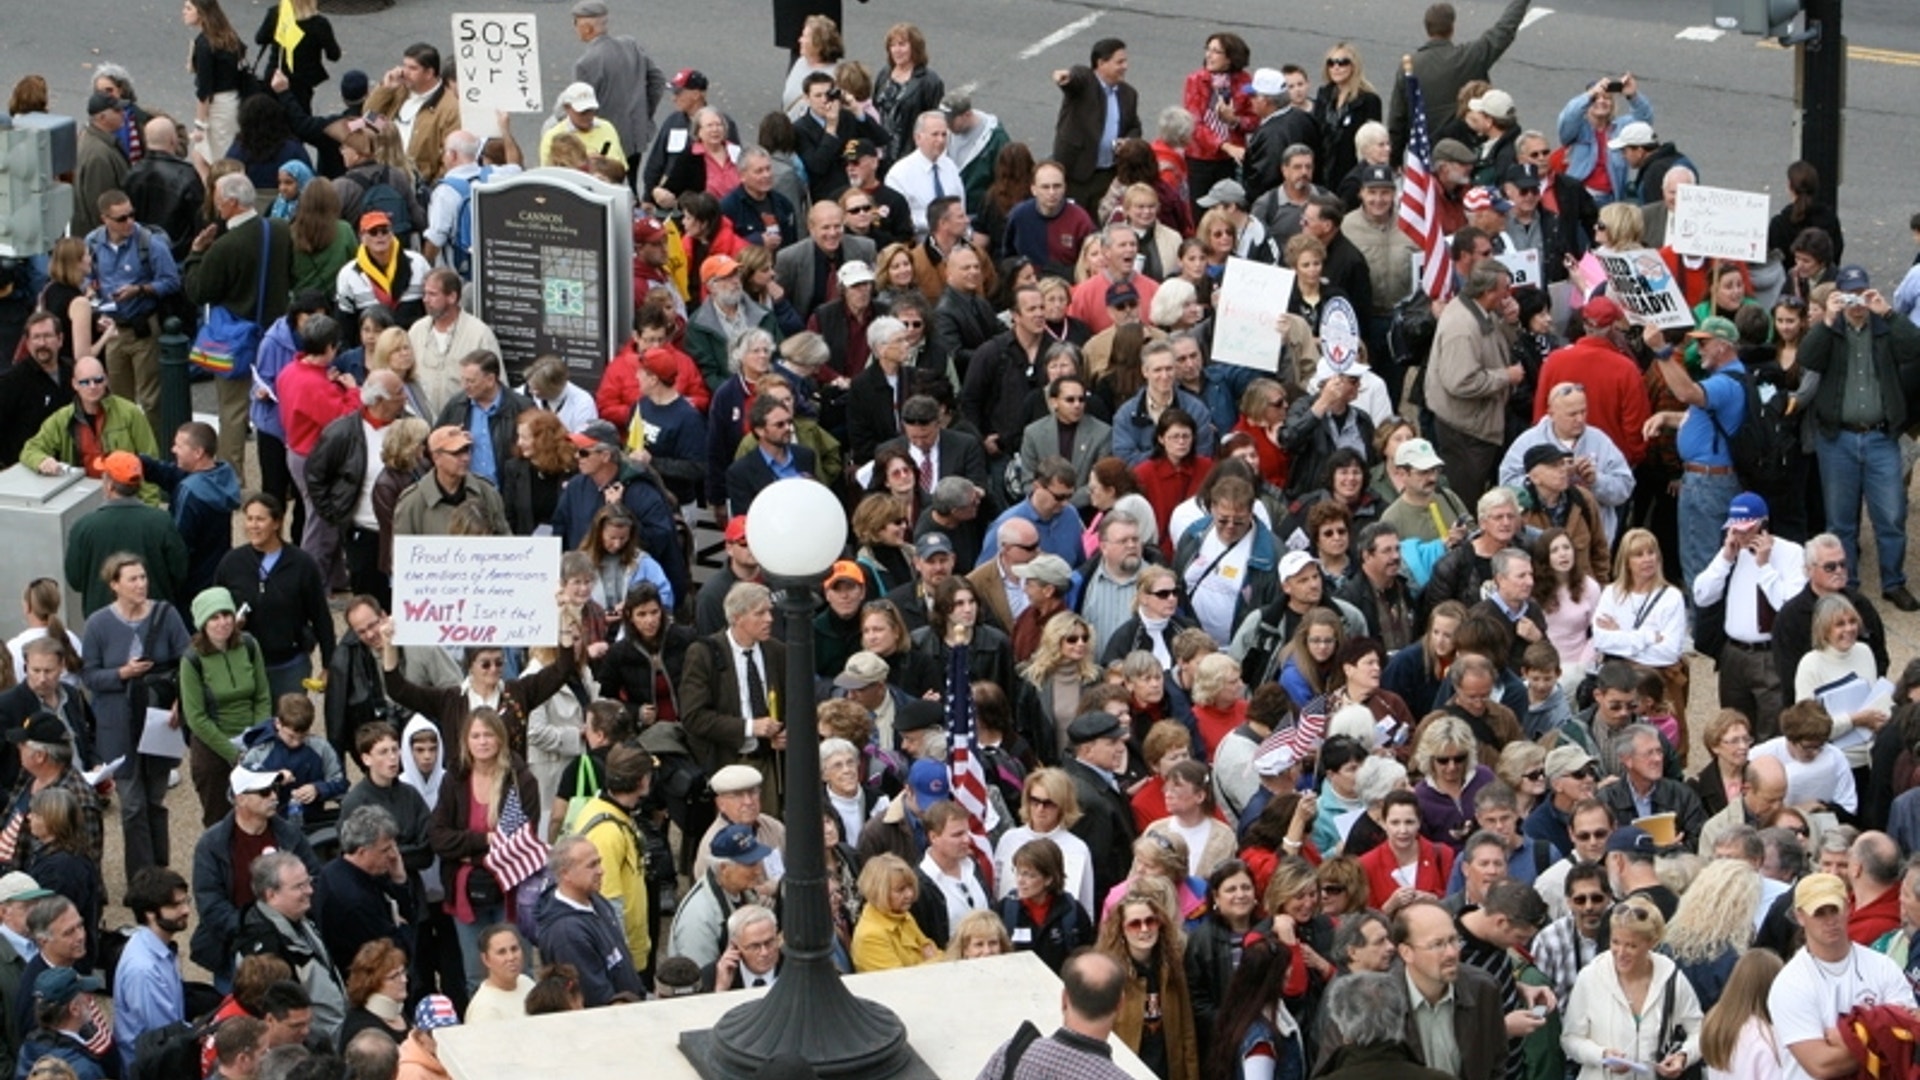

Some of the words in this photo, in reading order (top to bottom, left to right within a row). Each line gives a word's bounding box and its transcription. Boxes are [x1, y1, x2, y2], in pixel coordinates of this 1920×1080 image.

[519, 210, 563, 223] CANNON
[409, 544, 450, 564] Proud
[453, 548, 467, 564] to
[470, 546, 534, 566] represent
[485, 567, 549, 581] Americans
[403, 598, 466, 623] WAIT!
[438, 625, 497, 643] YOUR
